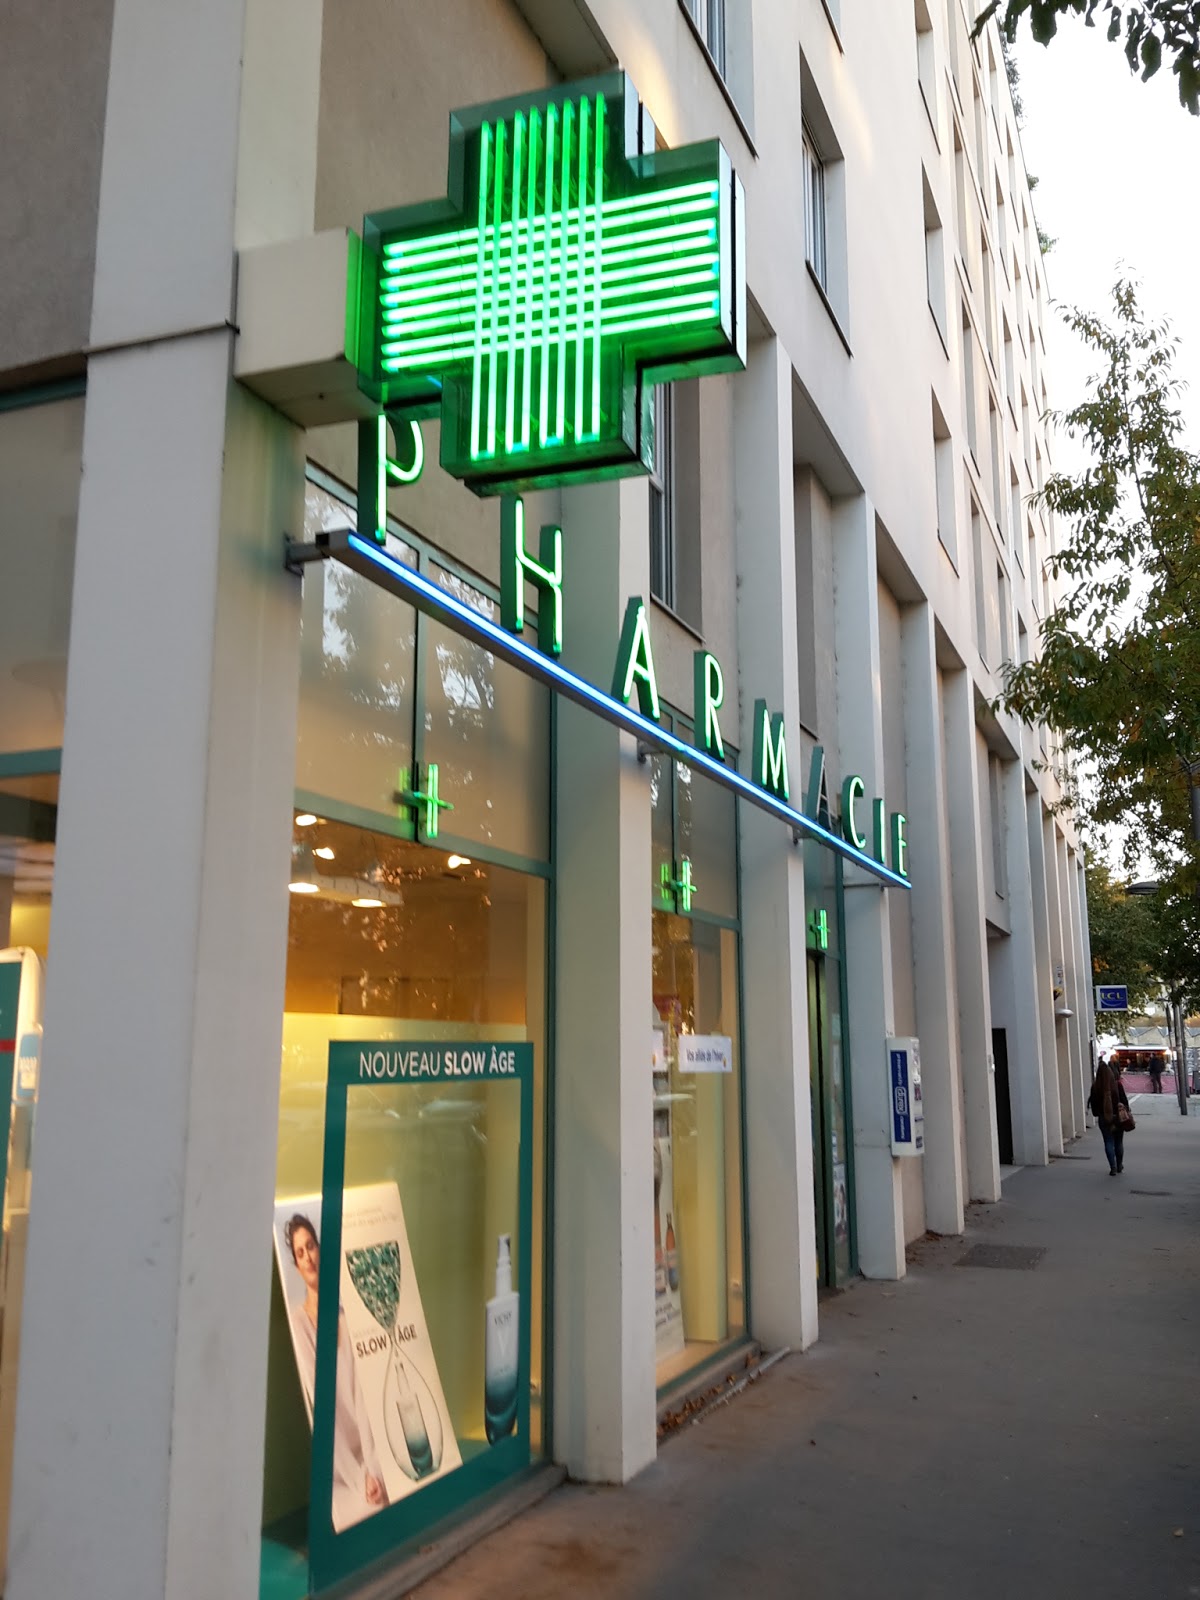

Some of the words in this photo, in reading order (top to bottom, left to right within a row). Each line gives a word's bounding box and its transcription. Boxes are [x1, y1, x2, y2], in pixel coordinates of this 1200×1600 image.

[357, 408, 909, 878] PHARMACIE
[359, 1050, 441, 1079] NOUVEAU
[444, 1050, 486, 1076] SLOW
[488, 1045, 516, 1074] ÂGE
[897, 1088, 906, 1112] durex
[355, 1333, 388, 1359] SLOW
